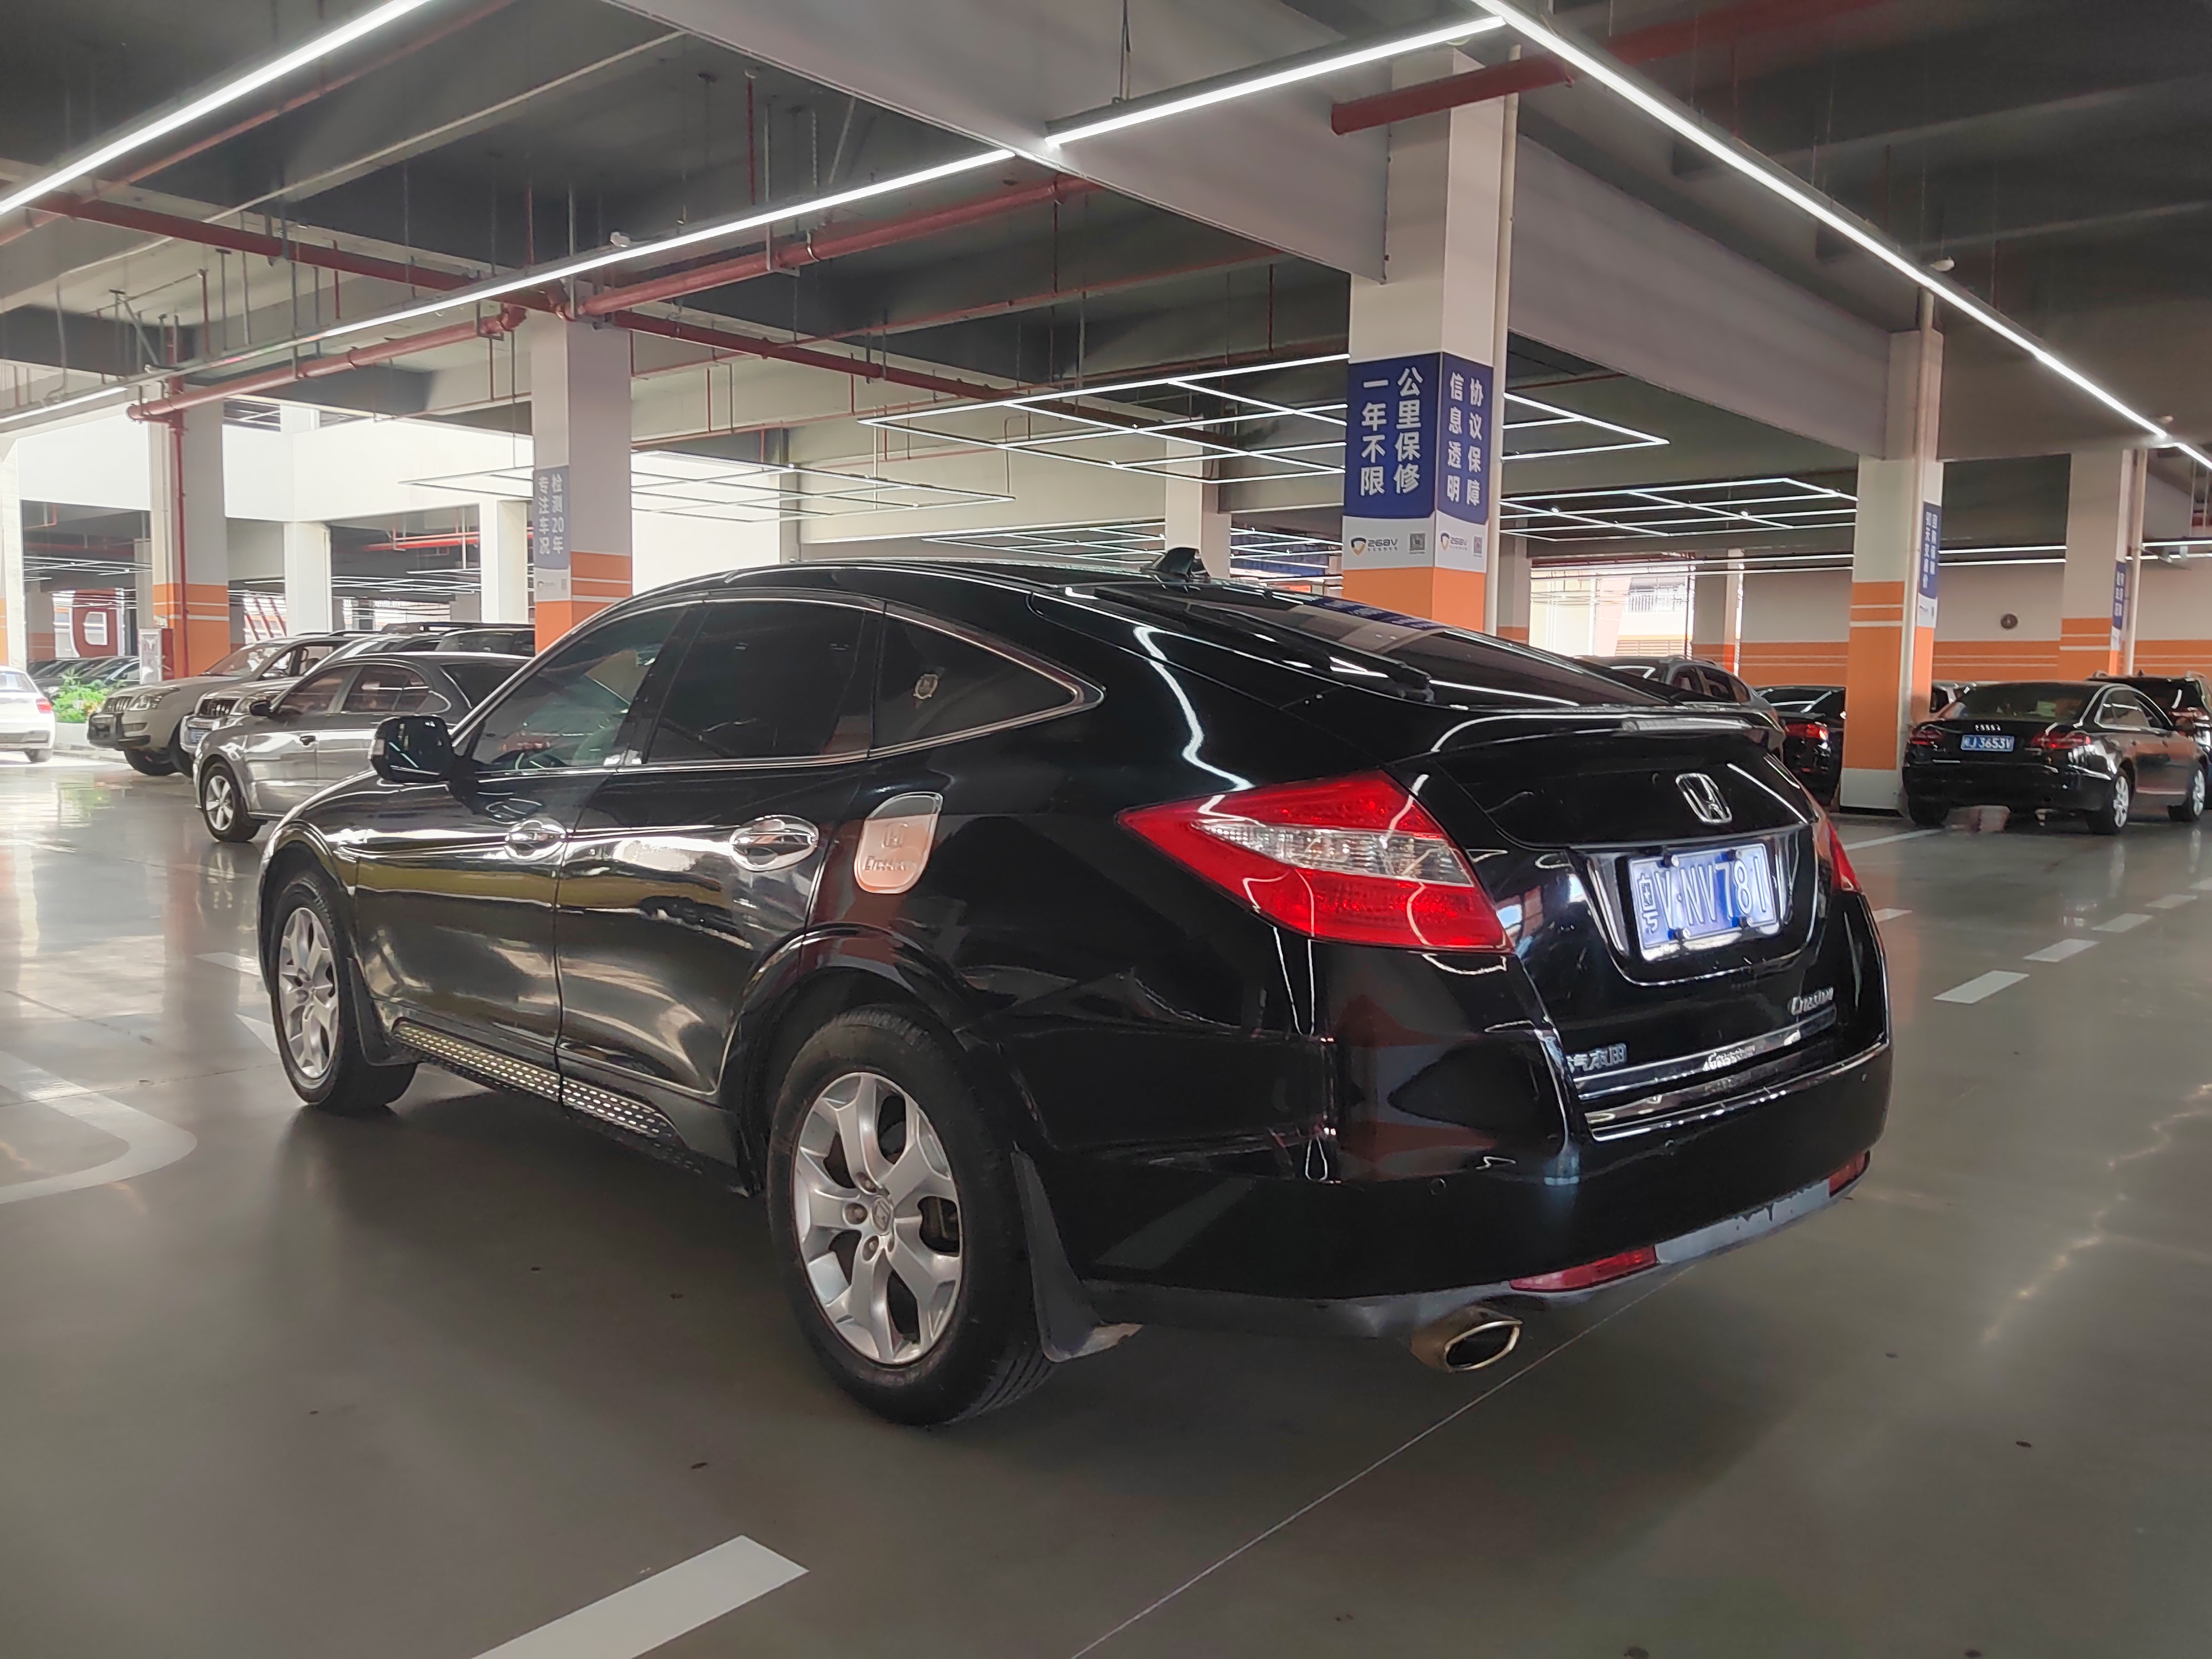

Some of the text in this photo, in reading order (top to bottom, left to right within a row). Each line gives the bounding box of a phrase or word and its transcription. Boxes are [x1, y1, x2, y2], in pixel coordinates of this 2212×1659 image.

[1360, 378, 1389, 496] 一年不限
[1393, 366, 1423, 495] 公里保修
[1447, 371, 1465, 503] 信息透明
[1466, 377, 1484, 507] 协议保障
